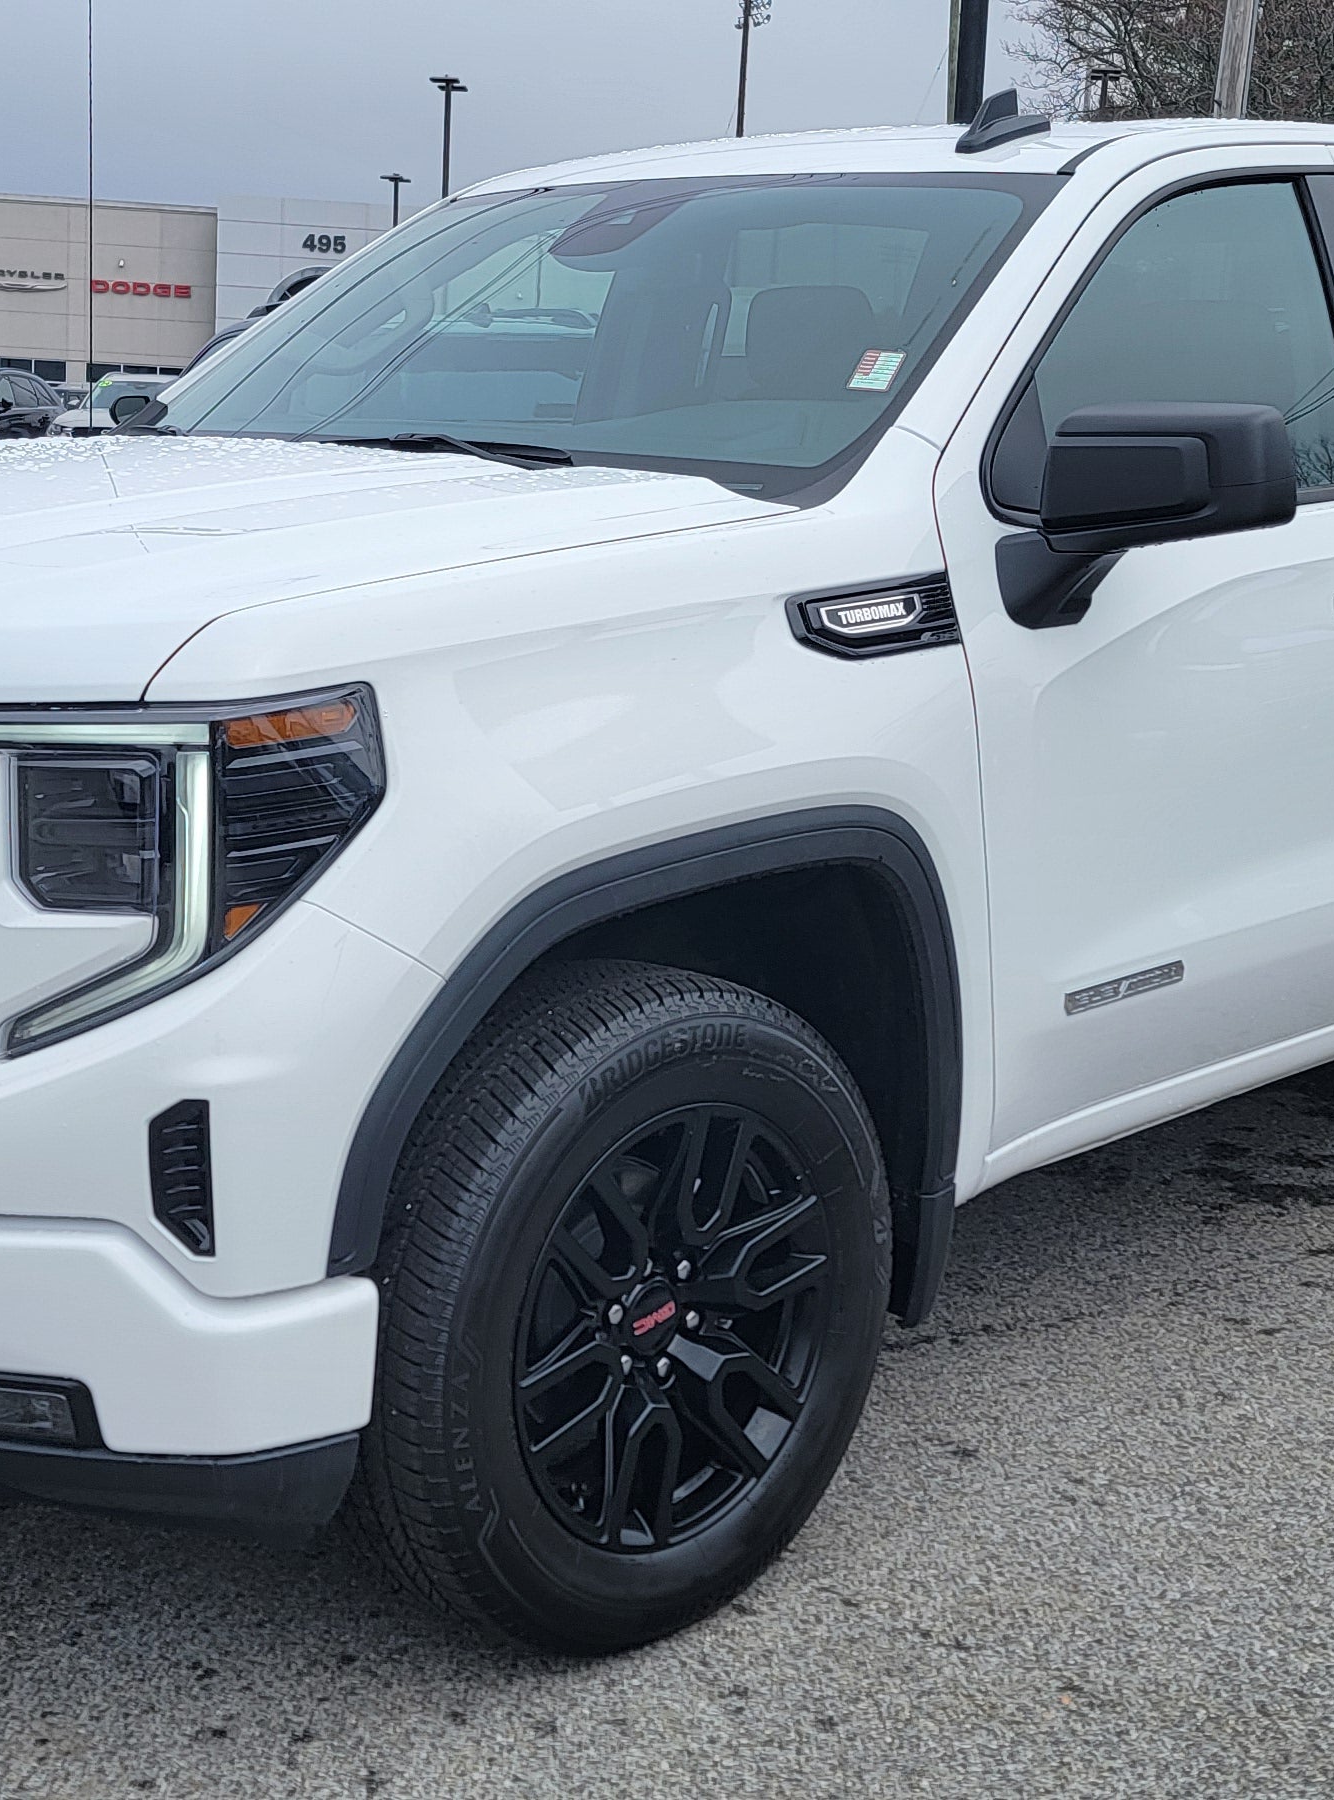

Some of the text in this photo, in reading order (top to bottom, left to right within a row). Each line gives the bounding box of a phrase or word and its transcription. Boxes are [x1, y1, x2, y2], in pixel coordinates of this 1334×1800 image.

[301, 233, 347, 254] 495
[91, 279, 191, 298] DODGE
[837, 602, 907, 625] TURBOMAX
[578, 1022, 748, 1112] BRIDGESTONE
[450, 1371, 484, 1513] ALENZA
